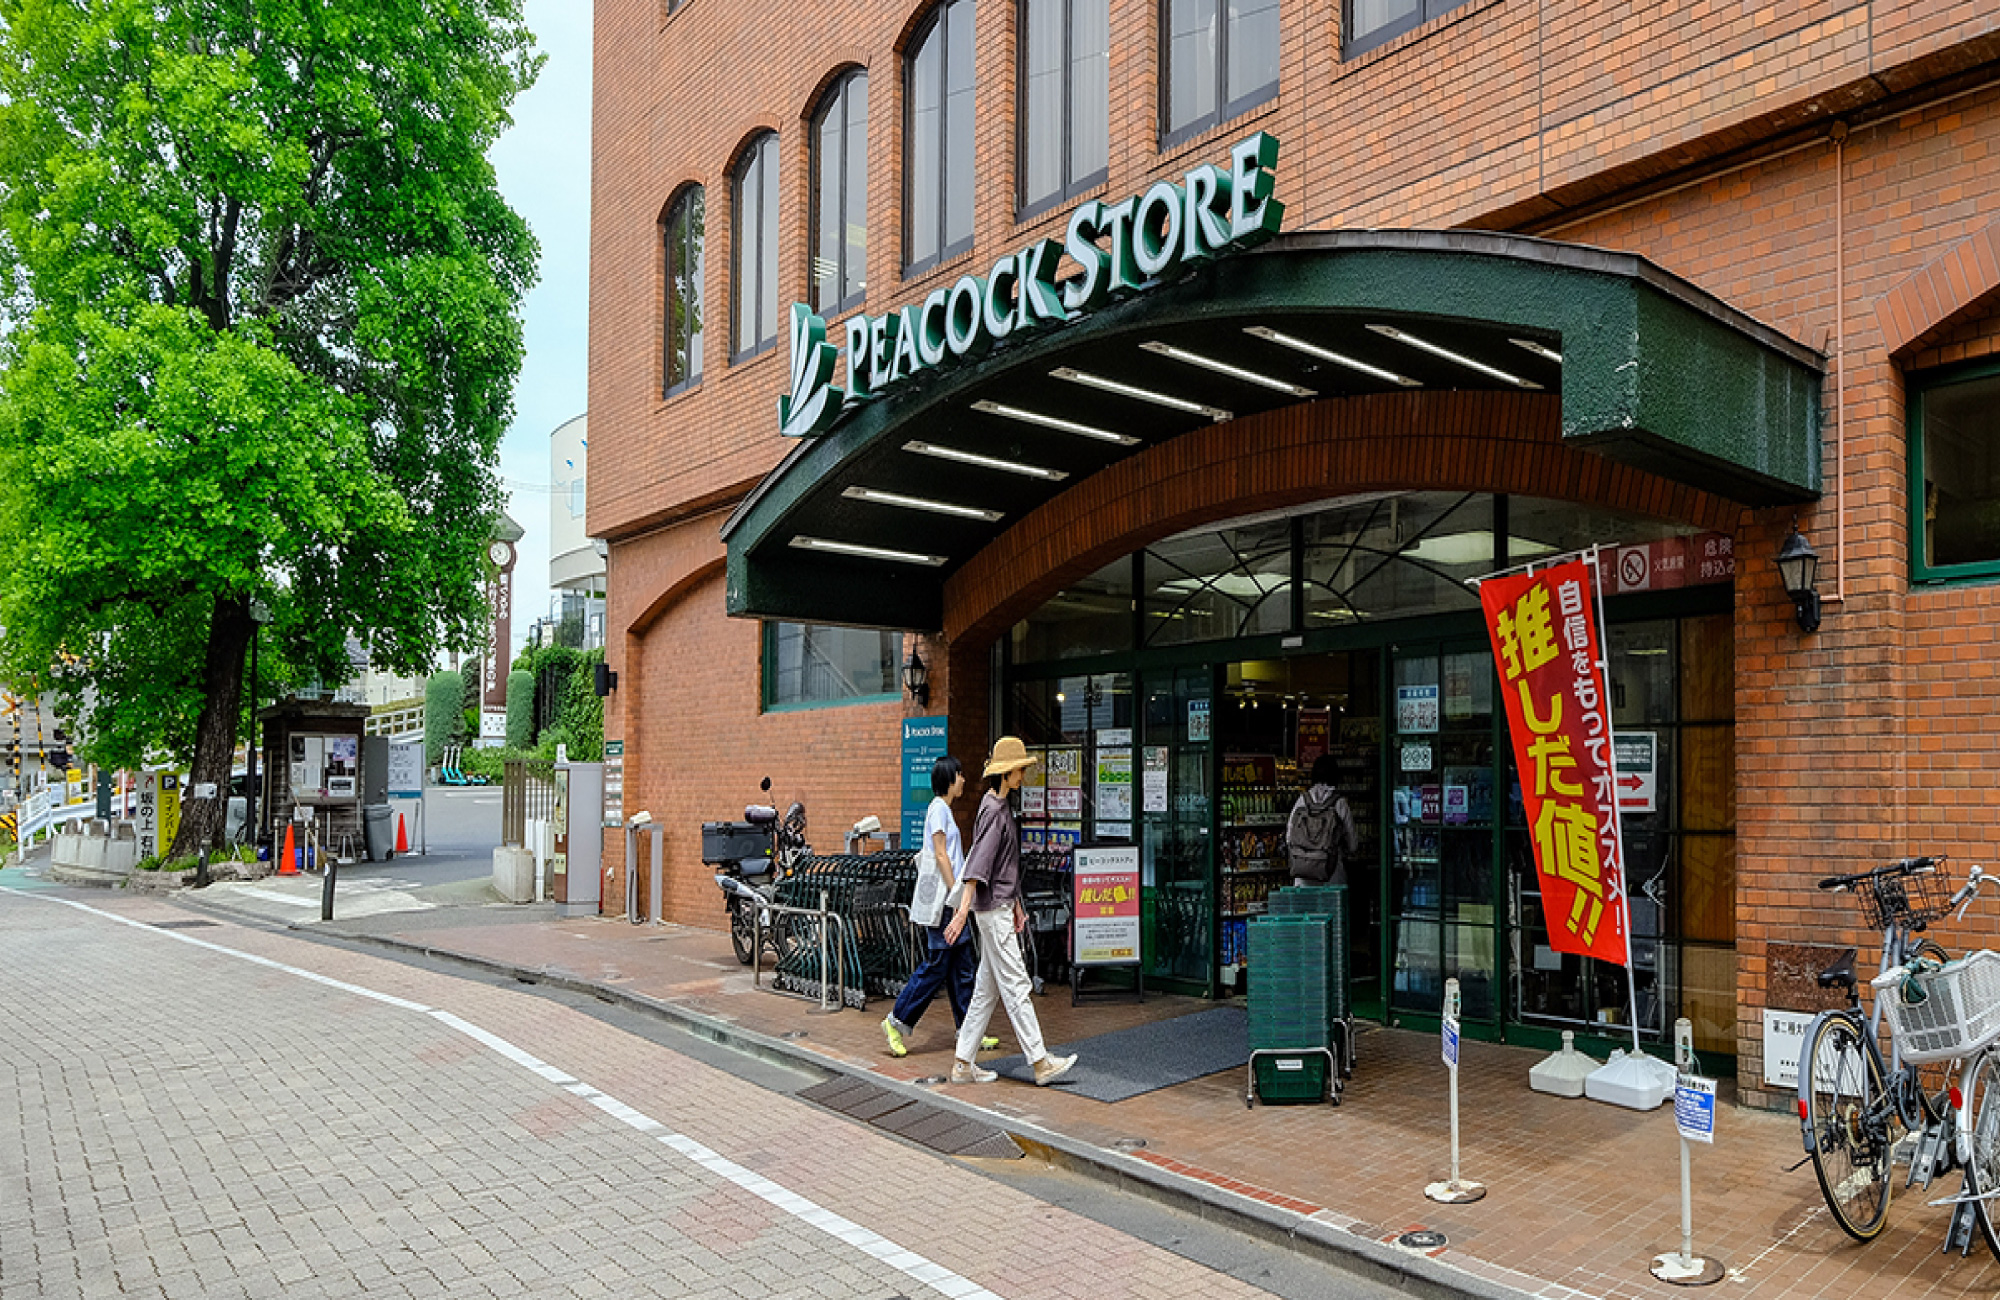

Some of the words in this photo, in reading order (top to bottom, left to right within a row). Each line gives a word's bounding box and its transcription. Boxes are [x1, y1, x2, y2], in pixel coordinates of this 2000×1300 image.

[845, 238, 1068, 400] PEACOCK
[1063, 131, 1280, 310] STORE
[165, 776, 175, 789] P
